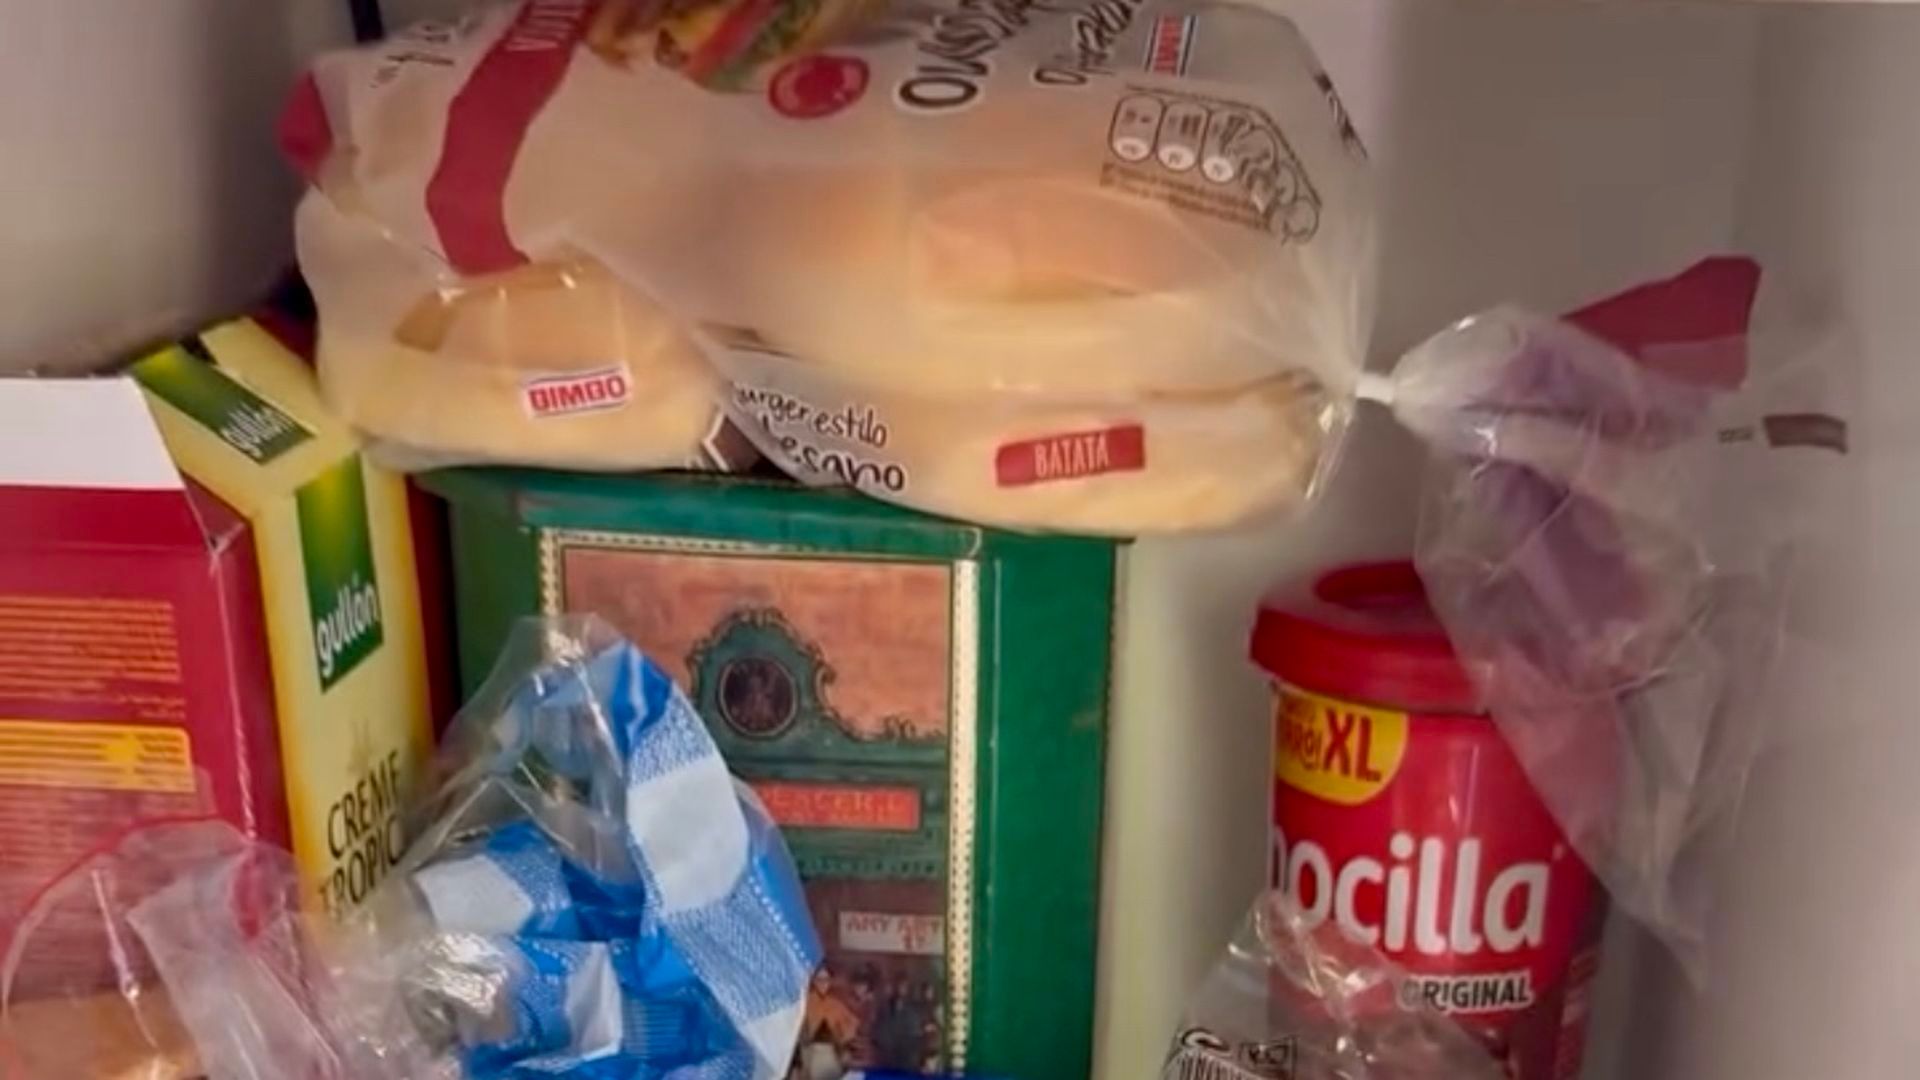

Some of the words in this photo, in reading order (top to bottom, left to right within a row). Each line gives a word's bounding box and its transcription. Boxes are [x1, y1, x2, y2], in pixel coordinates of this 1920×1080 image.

[527, 374, 626, 411] BIMBO
[814, 406, 888, 448] estilo
[1033, 433, 1110, 479] BATATA
[1323, 707, 1382, 782] XL
[1400, 974, 1530, 1012] ORIGINAL
